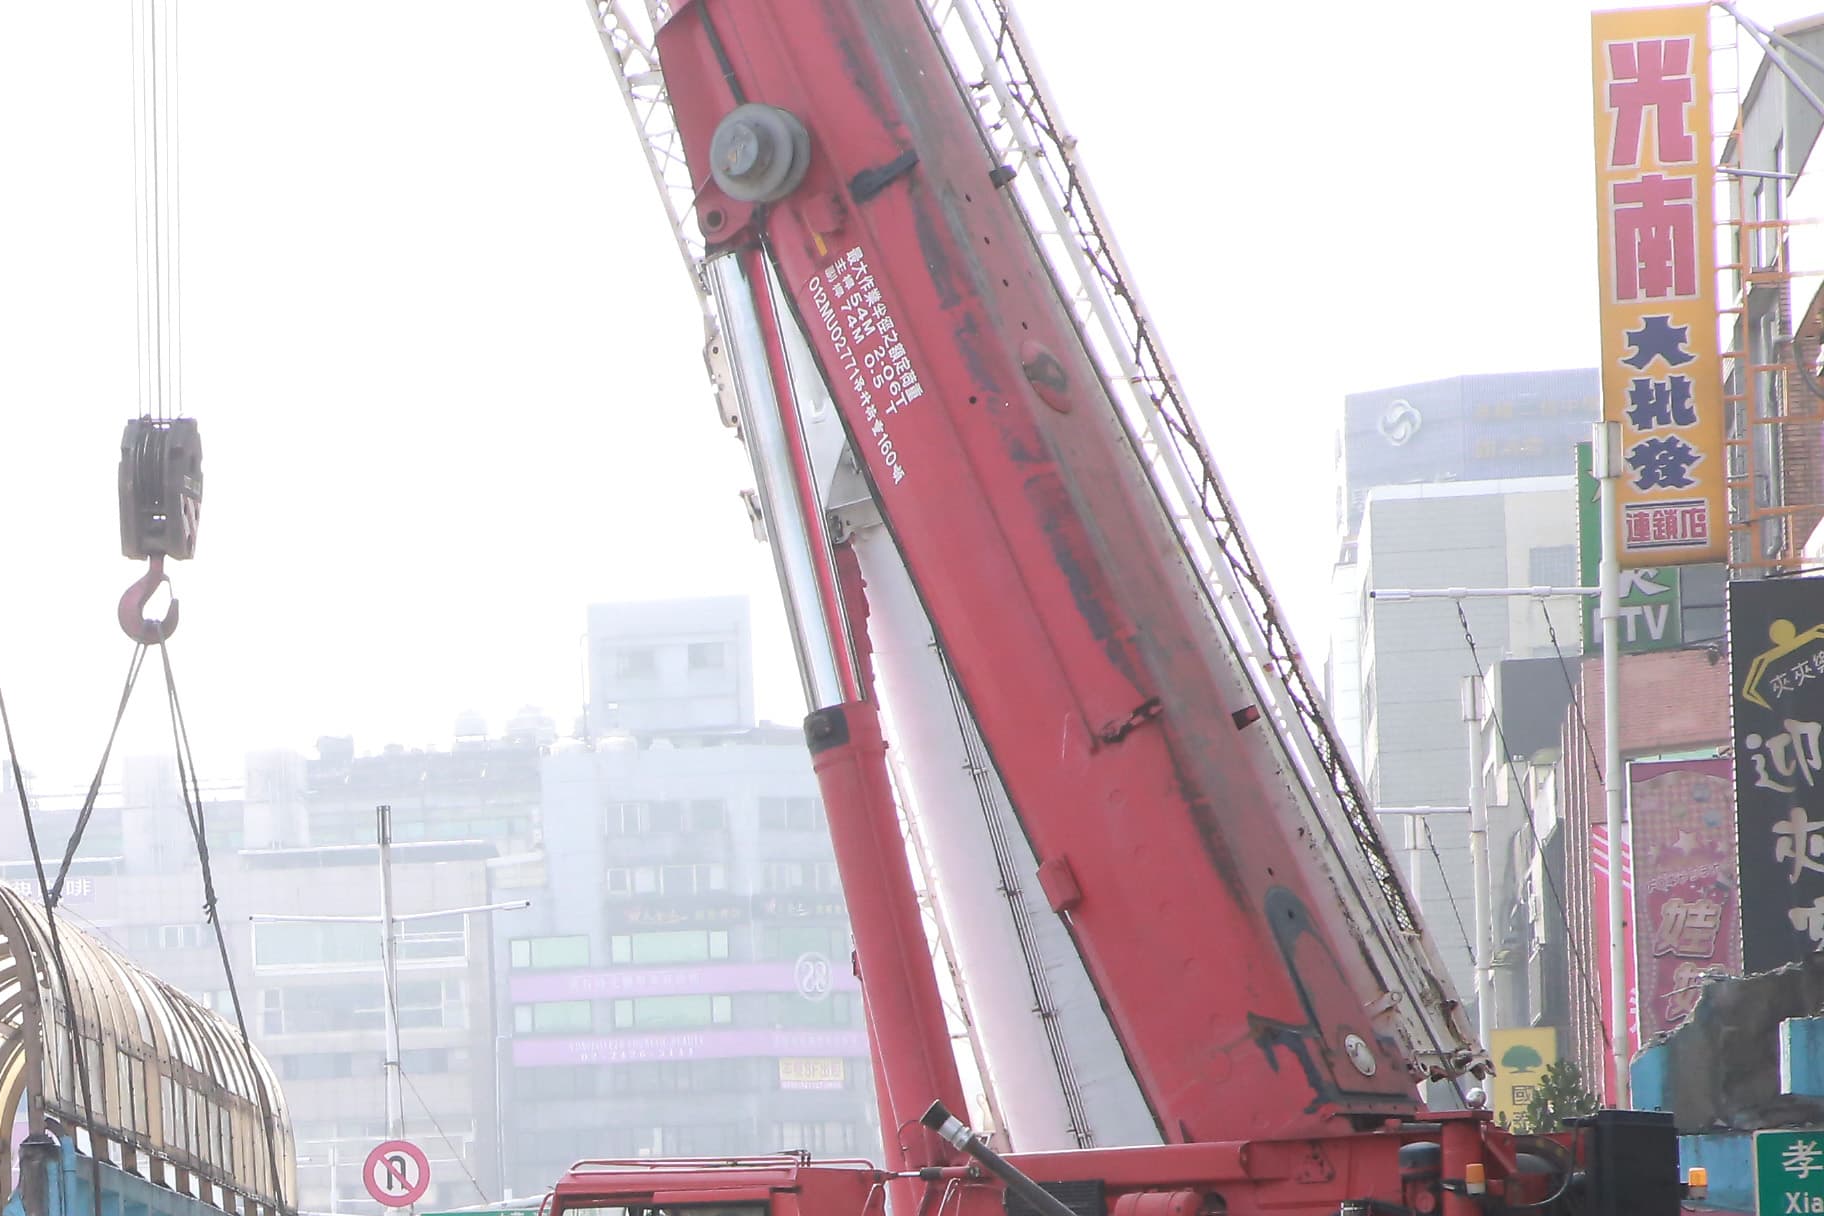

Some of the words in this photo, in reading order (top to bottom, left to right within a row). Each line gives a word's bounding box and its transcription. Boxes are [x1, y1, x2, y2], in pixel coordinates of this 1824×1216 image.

[1606, 37, 1698, 302] 光南
[840, 303, 864, 344] 74M
[849, 292, 876, 336] 54M
[1620, 315, 1704, 491] 大批發
[1626, 508, 1706, 541] 連鎖店
